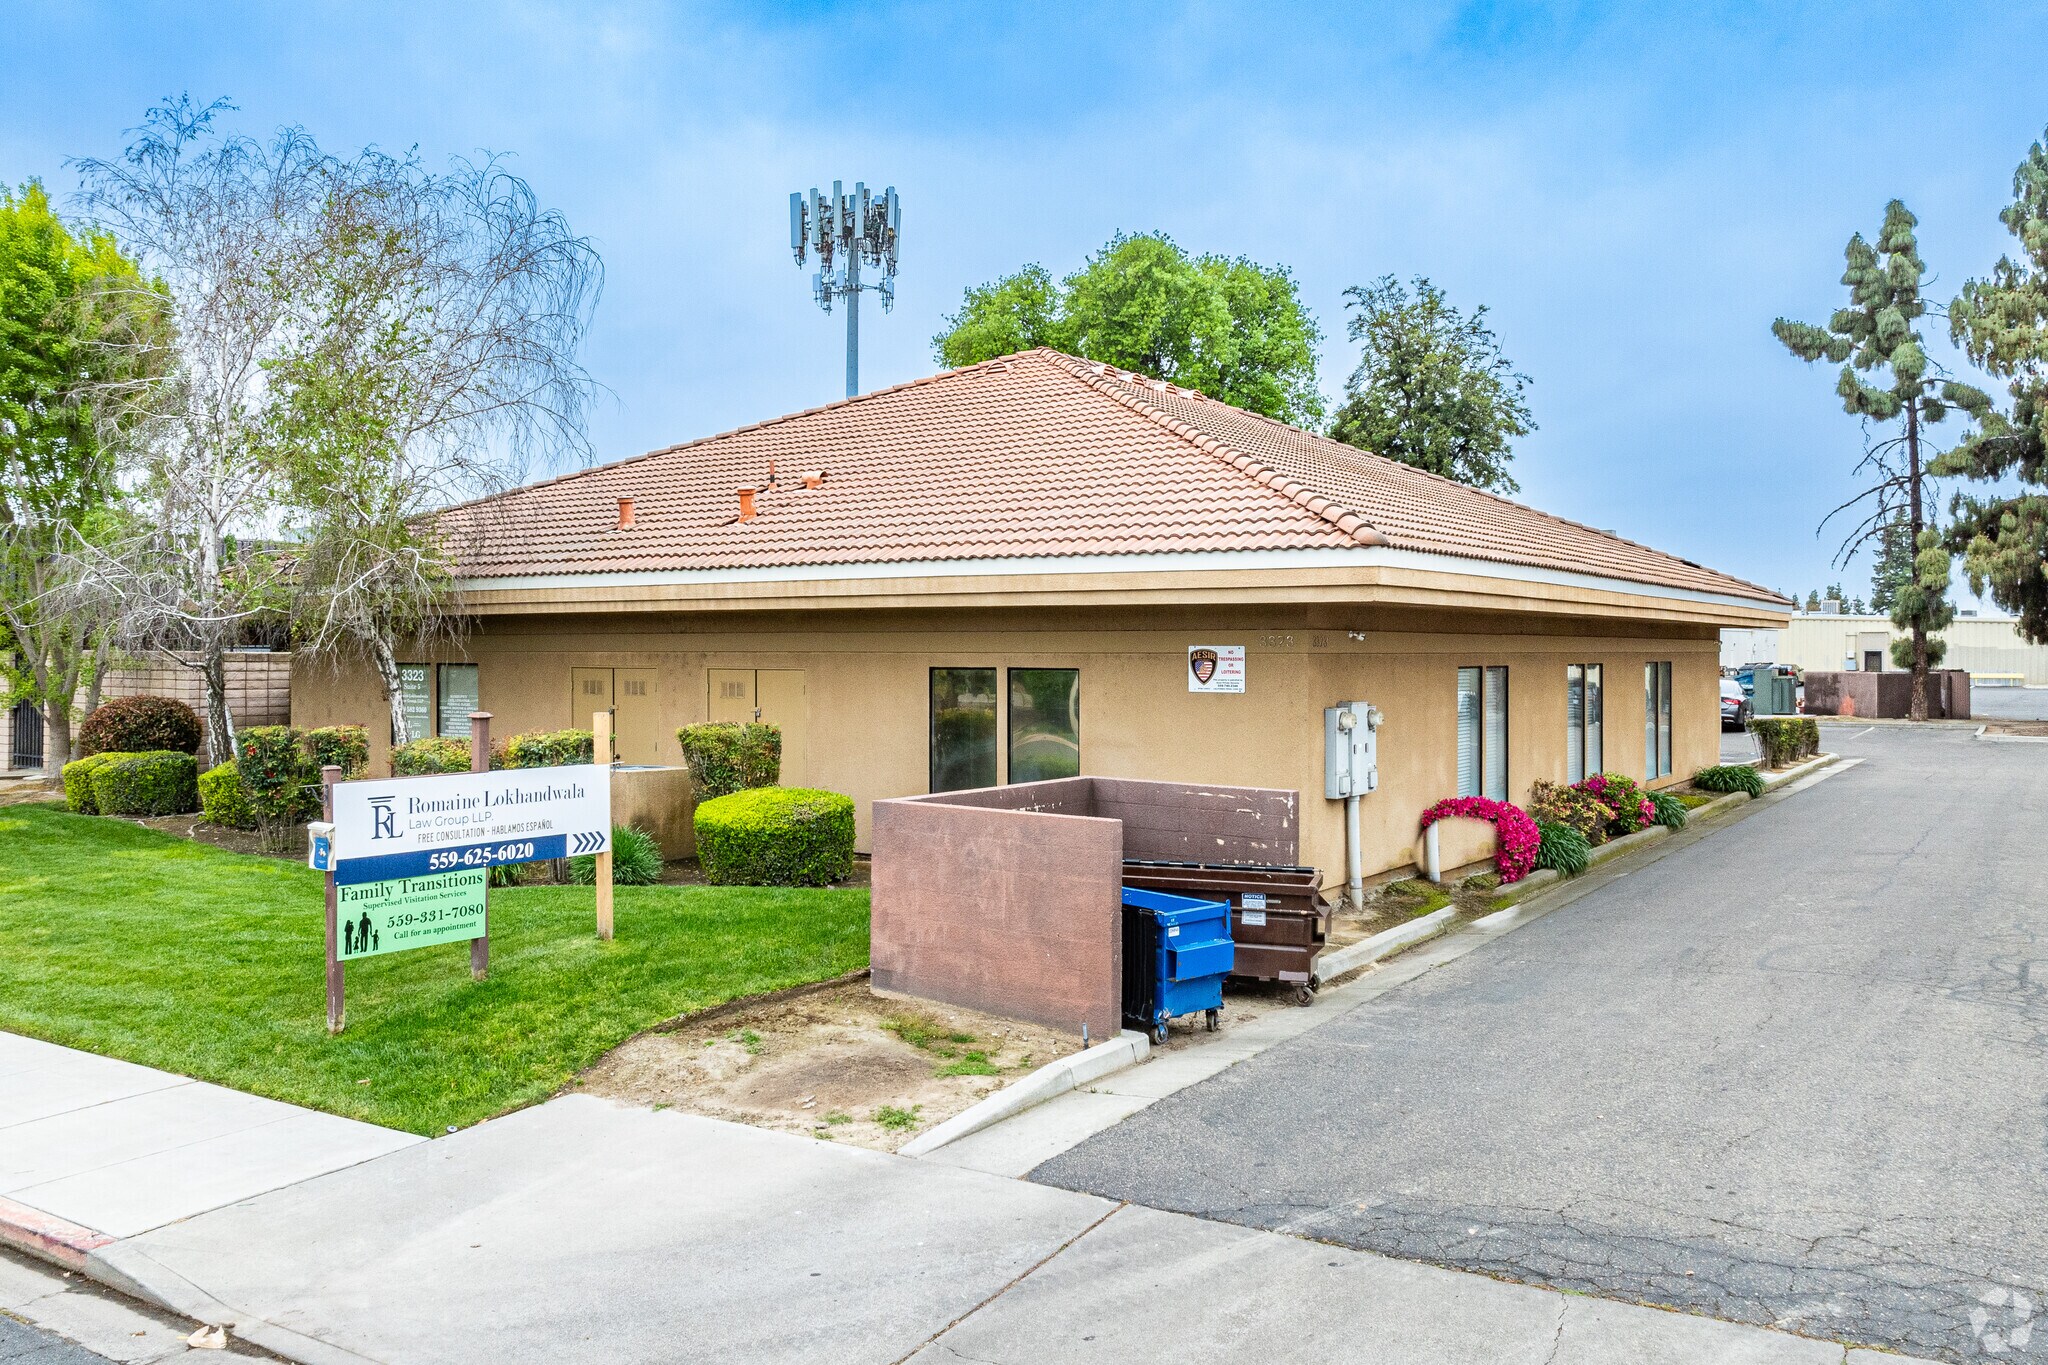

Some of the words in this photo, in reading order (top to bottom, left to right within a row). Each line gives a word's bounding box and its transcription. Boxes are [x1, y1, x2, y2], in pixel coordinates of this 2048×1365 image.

[1192, 650, 1216, 661] AESIR
[401, 669, 424, 681] 3323
[403, 682, 417, 690] Suite
[409, 793, 480, 815] Romaine
[485, 783, 585, 807] Lokhandwala
[409, 819, 432, 830] Law
[434, 815, 470, 827] Group
[417, 832, 434, 844] FREE
[436, 827, 485, 842] CONSULTATION
[491, 823, 525, 836] HABLAMOS
[526, 819, 554, 831] ESPAÑOL
[429, 842, 534, 870] 559-625-6020
[340, 882, 394, 902] Family
[398, 872, 483, 894] Transitions
[363, 897, 402, 911] Supervised
[404, 893, 438, 904] Visitation
[439, 890, 467, 900] Services
[387, 903, 484, 929] 559-331-7080
[393, 928, 409, 940] Call
[410, 926, 421, 936] for
[422, 927, 432, 935] an
[433, 921, 477, 935] appointment
